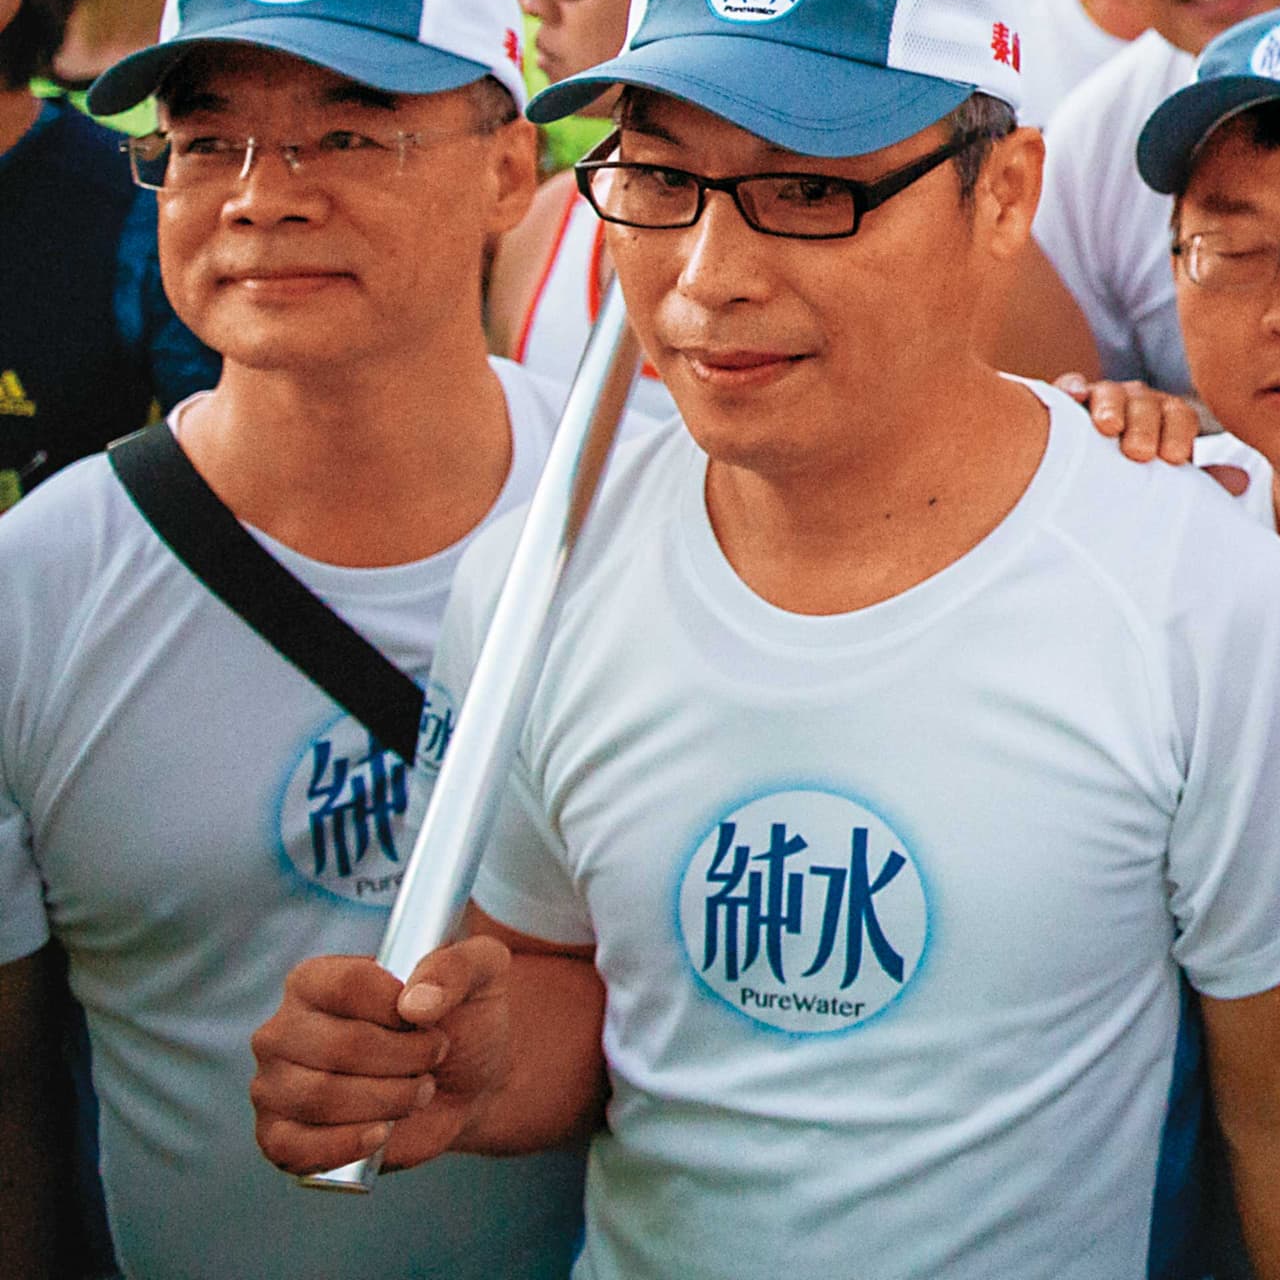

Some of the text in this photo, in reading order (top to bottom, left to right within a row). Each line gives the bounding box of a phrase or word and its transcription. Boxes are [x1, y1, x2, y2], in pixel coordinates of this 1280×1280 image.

[307, 741, 408, 877] 純
[702, 822, 907, 990] 純水
[740, 987, 866, 1018] PureWater
